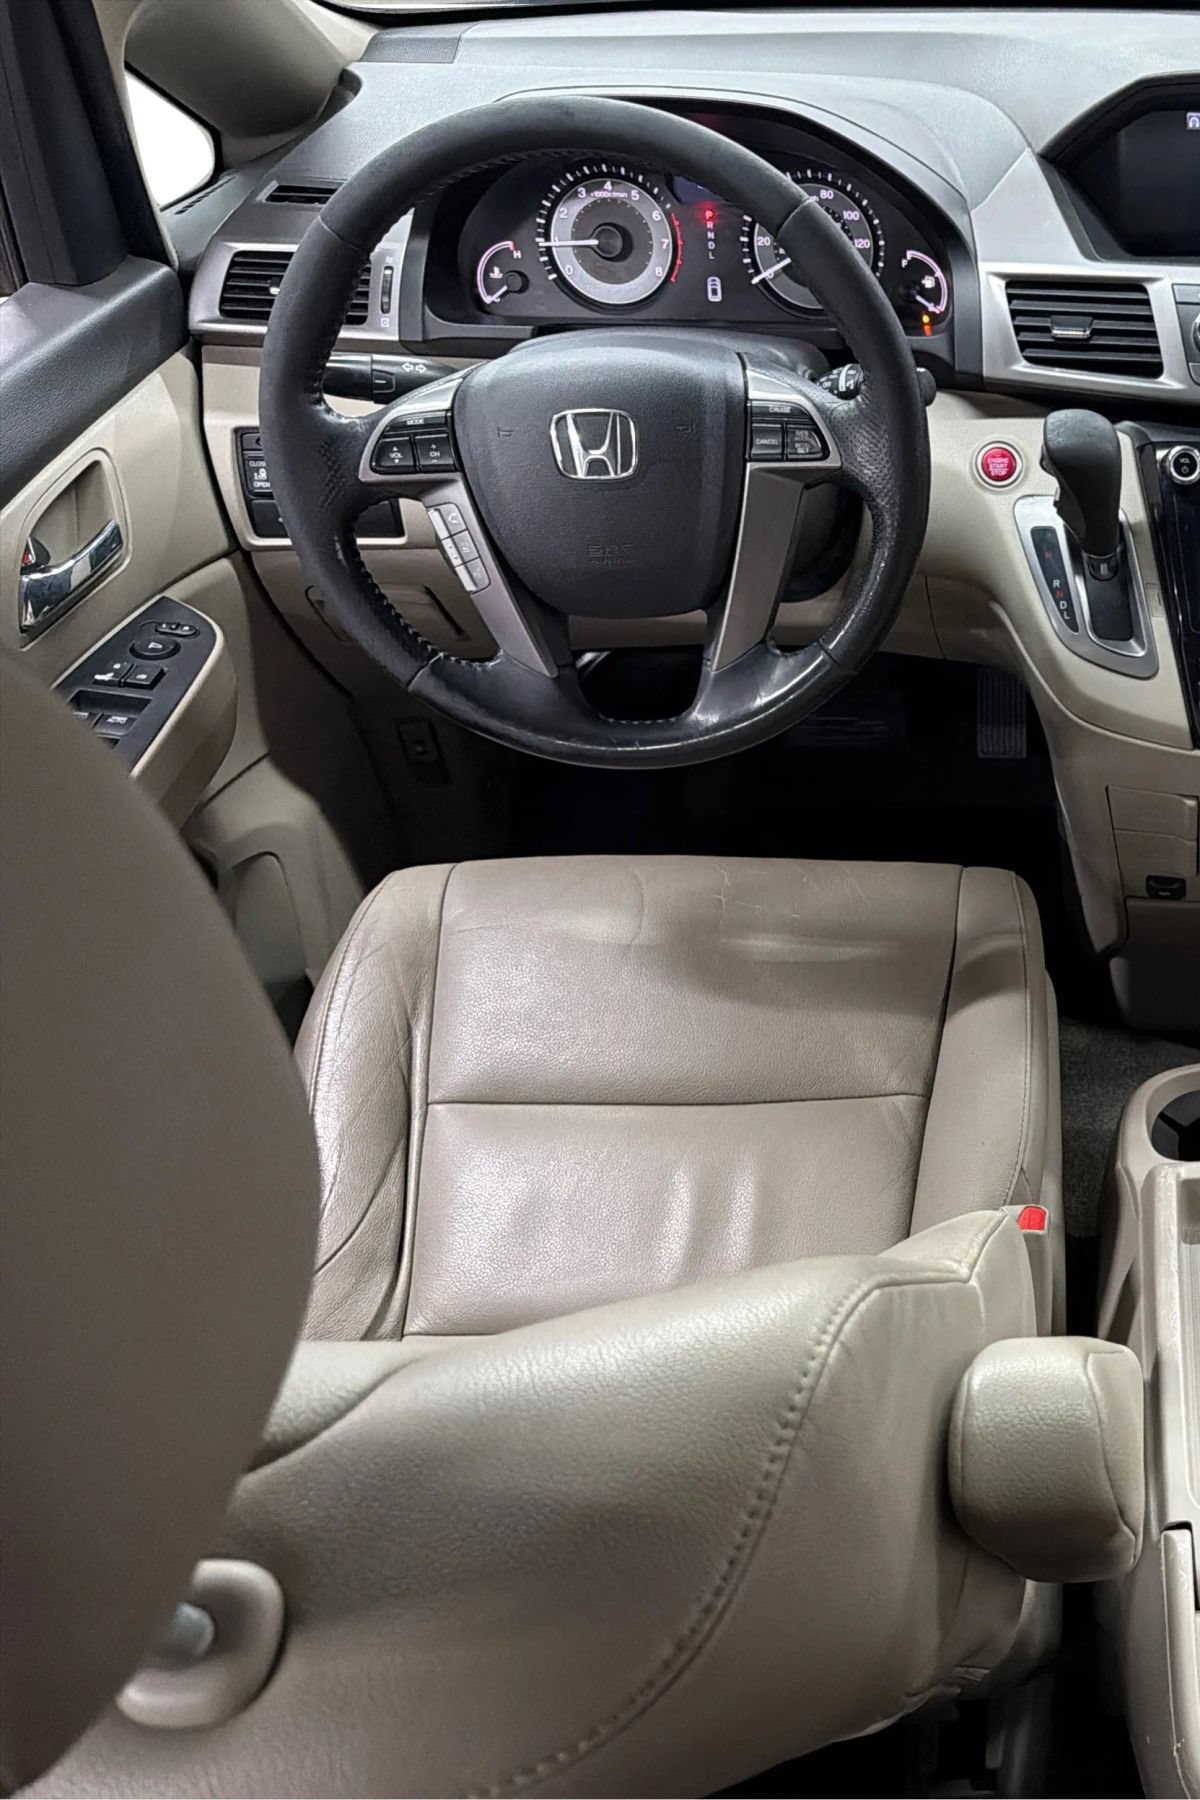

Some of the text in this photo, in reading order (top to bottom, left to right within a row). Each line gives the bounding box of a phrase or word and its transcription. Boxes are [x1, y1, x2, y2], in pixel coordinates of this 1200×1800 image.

[603, 181, 612, 191] 4
[578, 187, 586, 198] 3
[631, 190, 640, 200] 5
[820, 190, 834, 199] 80
[559, 208, 568, 218] 2
[652, 210, 661, 221] 6
[843, 211, 860, 221] 100
[705, 210, 716, 260] P R N D L
[661, 239, 669, 249] 7
[757, 236, 771, 246] 20
[854, 238, 871, 248] 120
[513, 250, 522, 259] H
[901, 258, 908, 268] F
[565, 264, 573, 275] 0
[655, 266, 663, 277] 8
[1053, 579, 1061, 588] R
[1060, 600, 1068, 610] D
[1064, 610, 1071, 620] L
